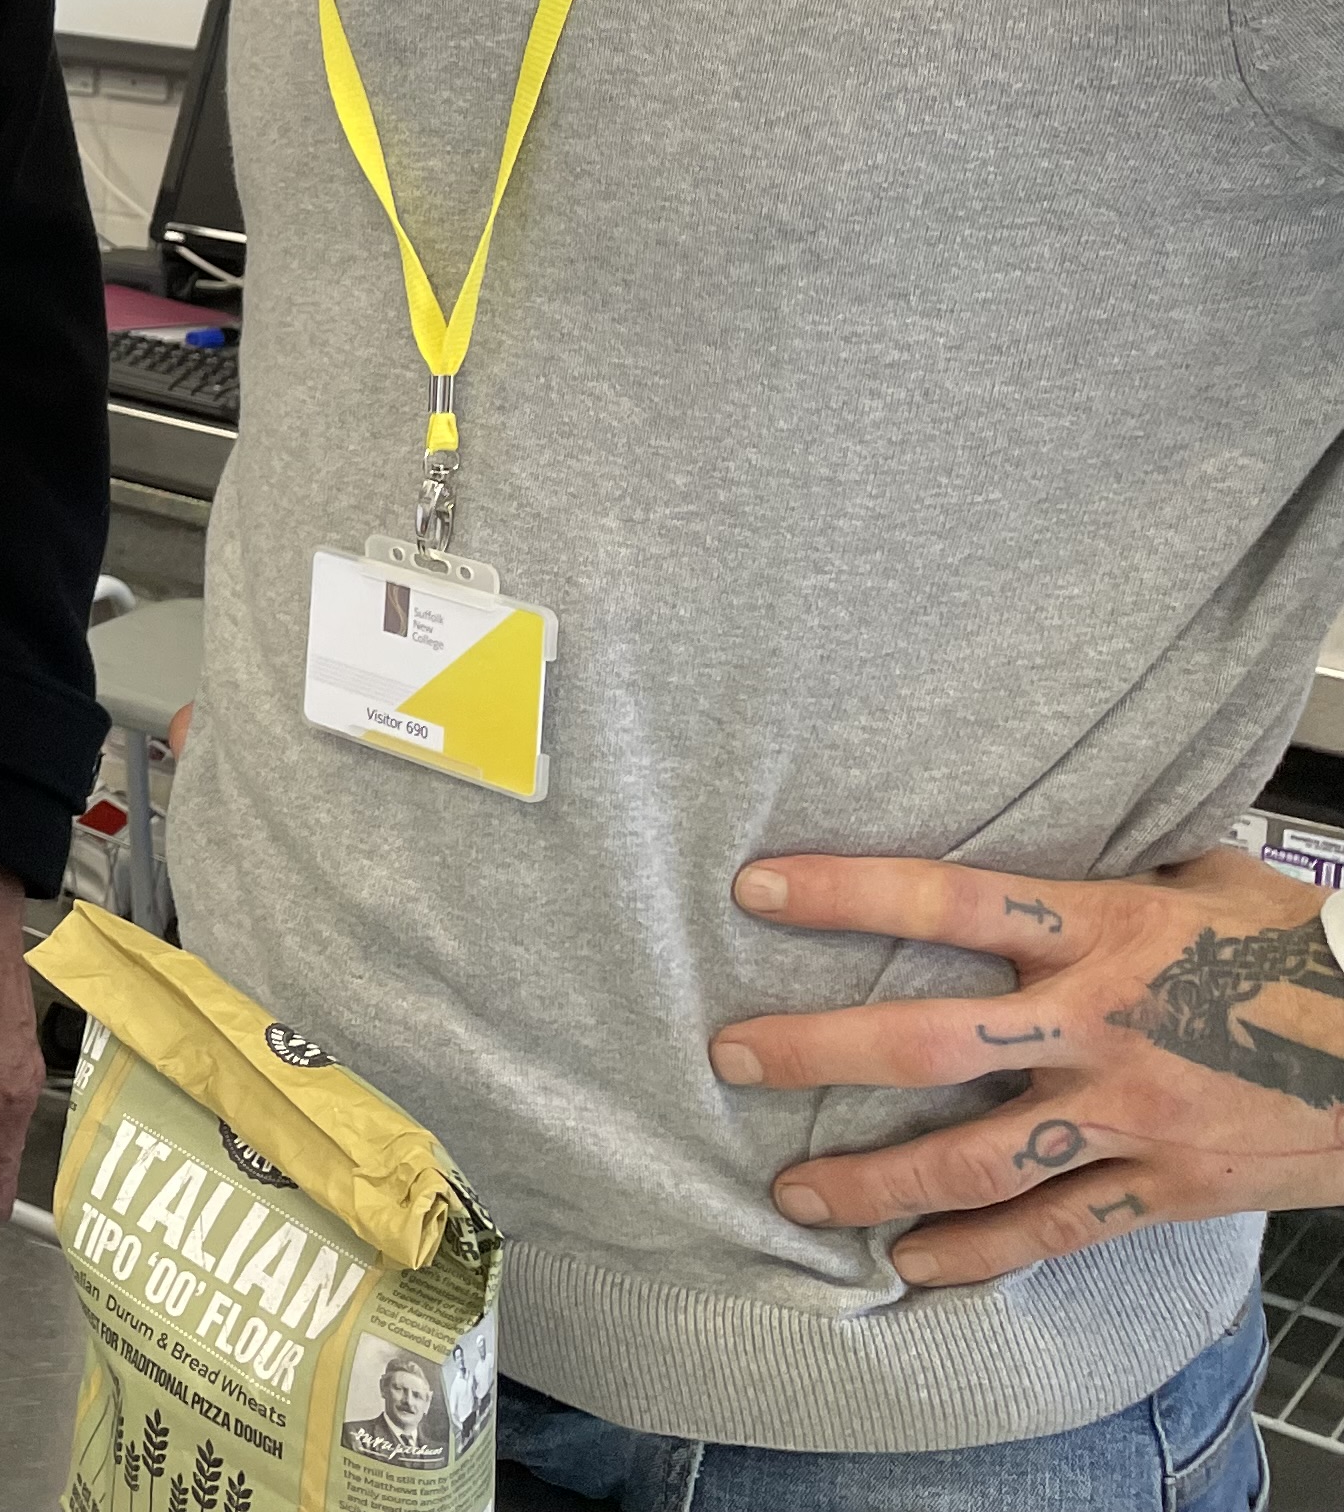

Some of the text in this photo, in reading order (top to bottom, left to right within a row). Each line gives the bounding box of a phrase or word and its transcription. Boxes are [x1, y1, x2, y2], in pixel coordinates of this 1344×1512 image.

[412, 631, 444, 651] College
[366, 707, 428, 739] Visitor 690
[90, 1119, 366, 1340] ITALIAN
[72, 1202, 142, 1281] TIPO
[195, 1290, 305, 1394] FLOUR
[369, 1314, 387, 1327] the
[386, 1320, 432, 1348] Cotswold
[375, 1303, 456, 1346] local populations
[105, 1293, 154, 1341] Durum
[156, 1332, 168, 1351] &
[170, 1341, 221, 1385] Bread
[221, 1374, 287, 1427] Wheats
[100, 1322, 283, 1460] FOR TRADITIONAL PIZZA DOUGH
[343, 1469, 362, 1482] the
[364, 1477, 418, 1496] Matthews
[344, 1456, 361, 1470] The
[363, 1466, 384, 1478] mill
[396, 1476, 415, 1485] still
[347, 1481, 380, 1501] family
[381, 1494, 418, 1506] source
[347, 1494, 368, 1506] and
